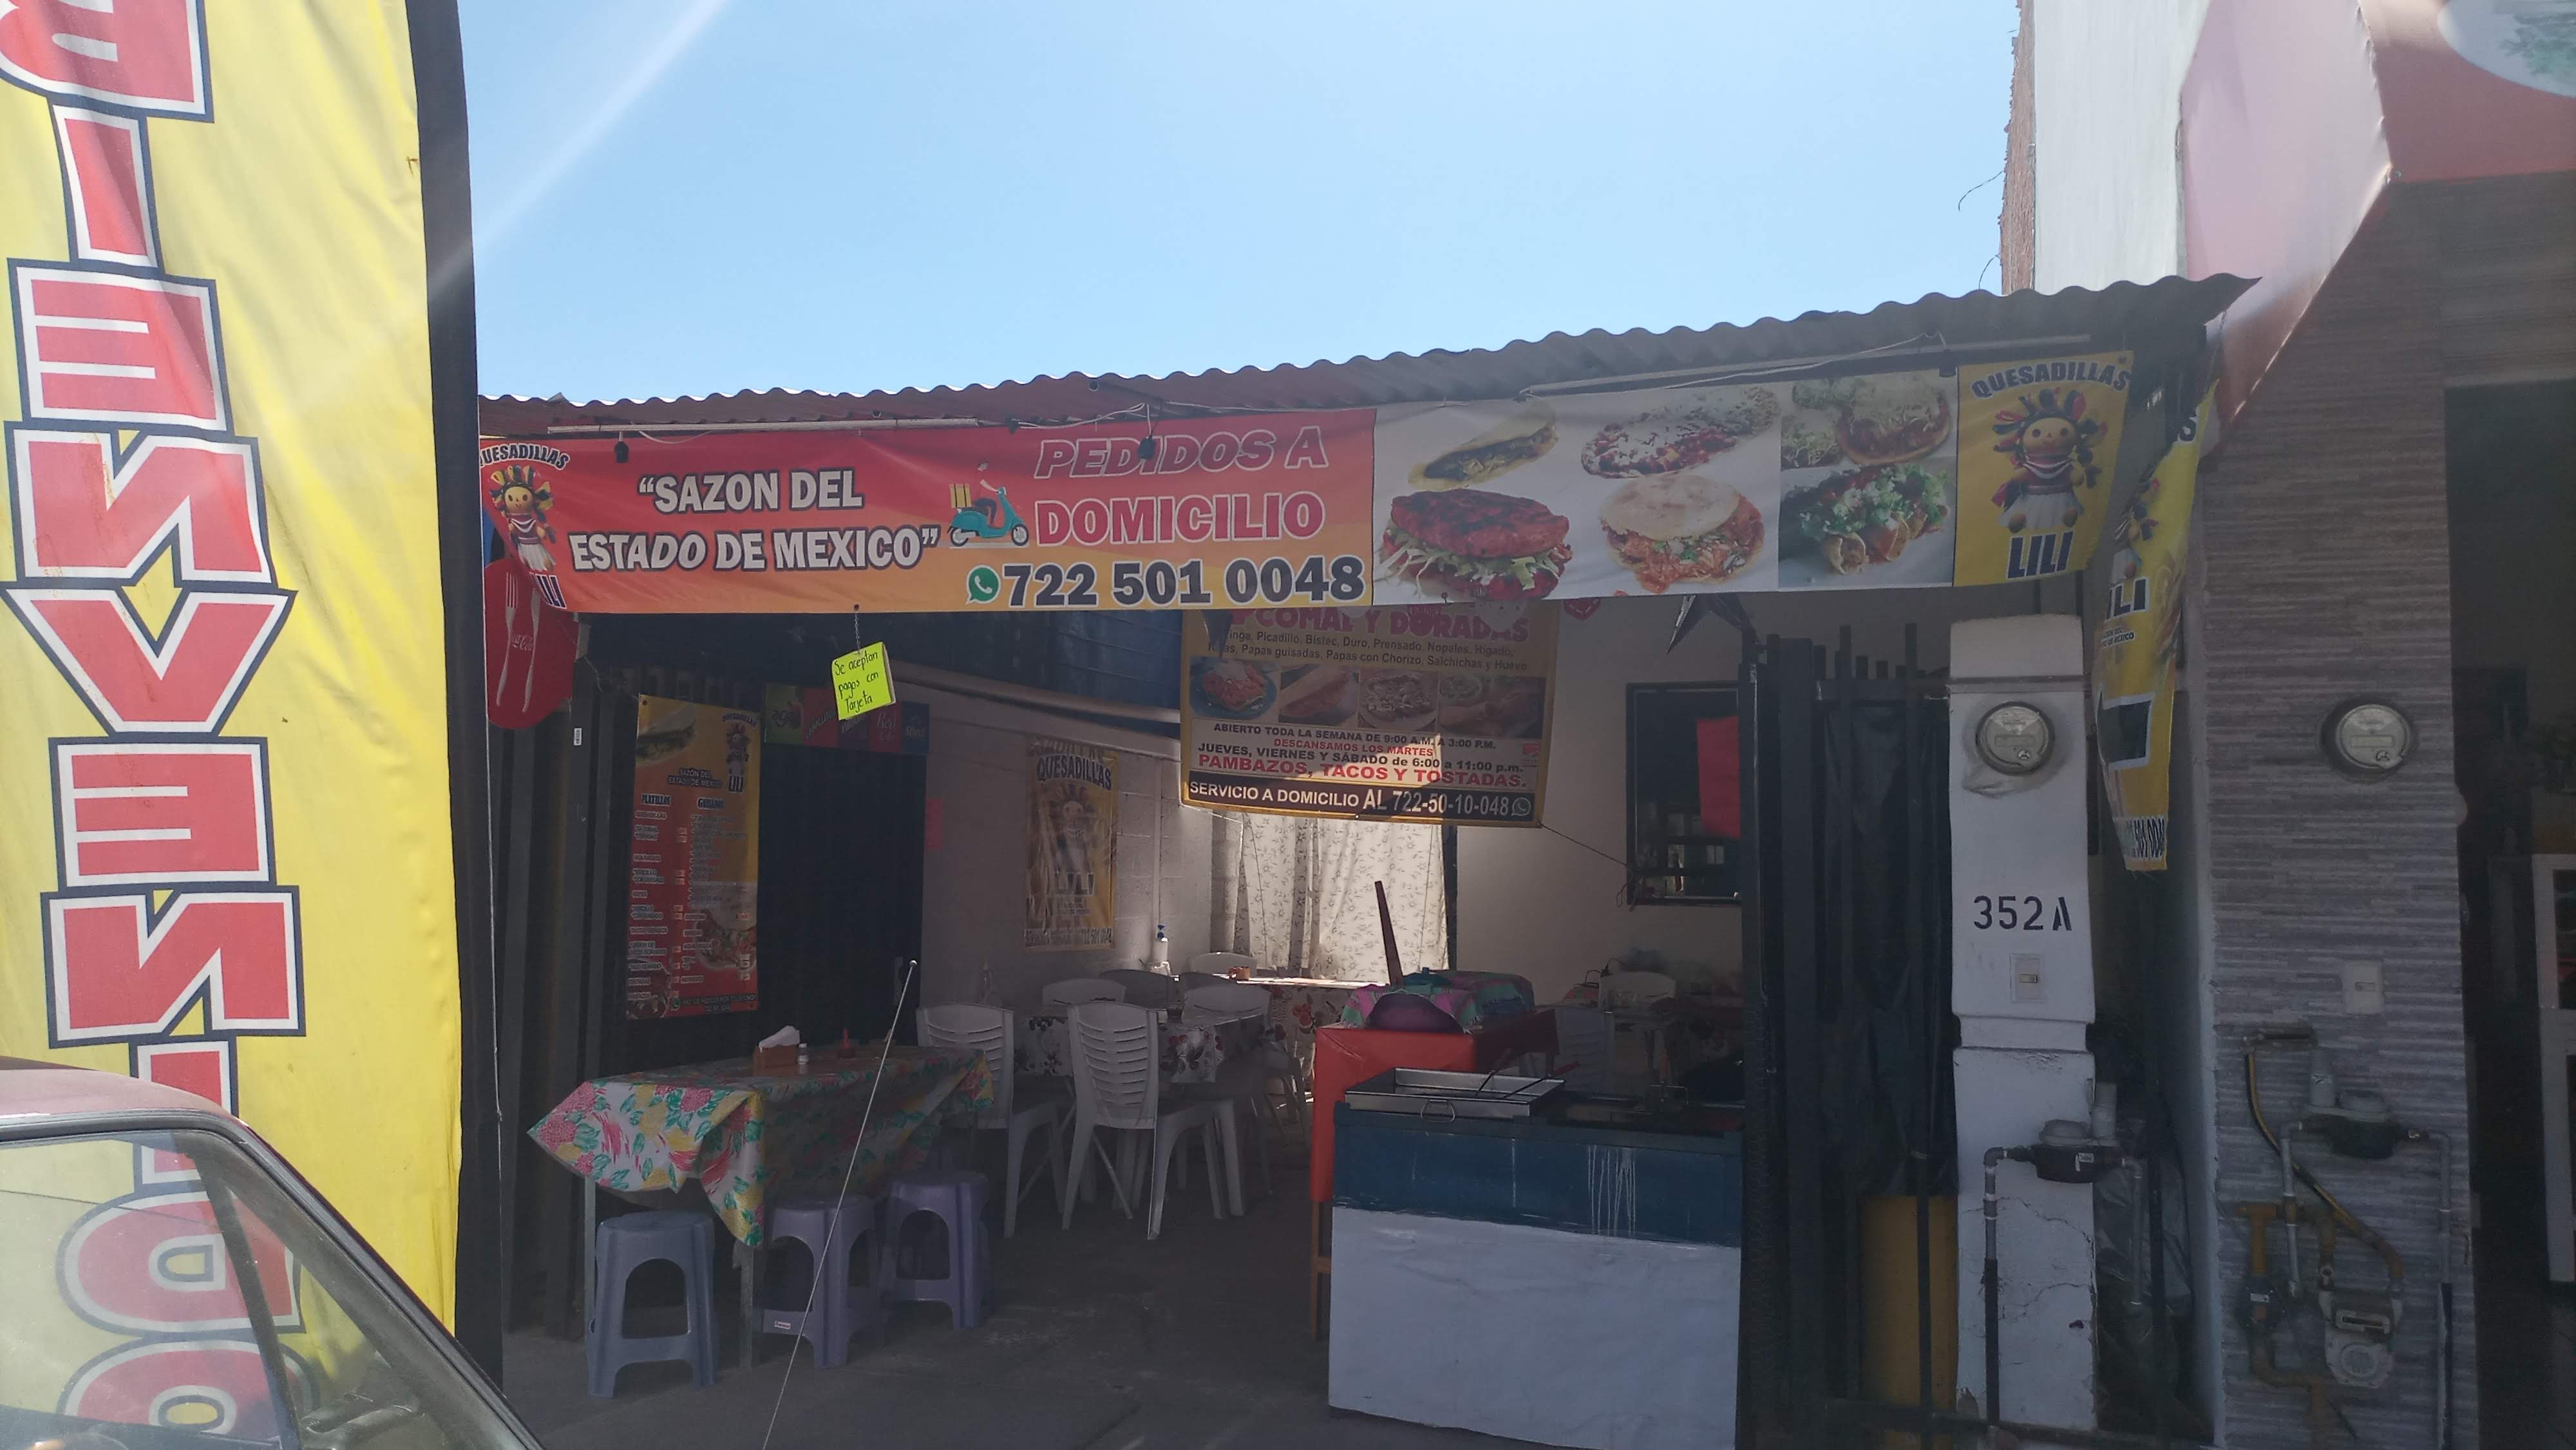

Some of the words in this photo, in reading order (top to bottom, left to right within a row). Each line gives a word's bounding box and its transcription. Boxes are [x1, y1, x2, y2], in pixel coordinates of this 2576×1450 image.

[1971, 362, 2131, 400] QUESADILLAS
[480, 443, 569, 469] UESADILLAS
[1033, 429, 1276, 479] PEDIDOS
[1285, 426, 1329, 469] A
[789, 467, 865, 510] DEL
[1034, 491, 1325, 546] DOMICILIO
[569, 532, 707, 571] ESTADO
[714, 530, 766, 570] DE
[2005, 531, 2074, 581] LILI
[1003, 563, 1097, 607] 722
[1112, 558, 1211, 606] 501
[1225, 554, 1365, 605] 0048
[1255, 607, 1353, 632] COMAL
[1365, 609, 1381, 633] Y
[1229, 631, 1253, 643] inga,
[1306, 636, 1339, 647] Bistec,
[1343, 637, 1370, 649] Duro,
[1242, 644, 1271, 656] Papas
[1275, 648, 1322, 661] guisadas,
[1327, 650, 1357, 662] Papas
[1360, 654, 1379, 662] con
[1427, 655, 1482, 669] Salchichas
[1485, 662, 1492, 671] y
[1494, 661, 1528, 670] Huevo
[834, 660, 845, 676] Se
[848, 650, 878, 671] aceptan
[838, 679, 860, 700] pagos
[866, 672, 879, 683] con
[844, 690, 873, 713] Tarjeta
[1214, 723, 1260, 734] ABIERTO
[1265, 727, 1294, 737] TODA
[1298, 729, 1312, 738] LA
[1316, 730, 1362, 741] SEMANA
[1365, 734, 1381, 743] DE
[1385, 734, 1406, 744] 9:00
[1410, 736, 1435, 746] A.M.
[1437, 737, 1444, 746] A
[1448, 739, 1472, 748] 3:00
[1474, 740, 1496, 749] P.M.
[1274, 739, 1359, 752] DESCANSAMOS
[1362, 744, 1384, 754] LOS
[1388, 746, 1434, 757] MARTES
[1036, 754, 1112, 791] QUESADILLAS
[1198, 743, 1252, 757] JUEVES,
[1256, 747, 1315, 760] VIERNES
[1320, 751, 1329, 761] Y
[1332, 751, 1388, 766] SÁBADO
[1392, 756, 1408, 766] de
[1412, 758, 1440, 768] 6:00
[1457, 760, 1492, 773] 11:00
[1496, 763, 1524, 774] p.m.
[1198, 753, 1313, 778] PAMBAZOS,
[1320, 763, 1388, 780] TACOS
[1393, 767, 1408, 782] Y
[1414, 769, 1526, 788] TOSTADAS.
[1189, 780, 1259, 800] SERVICIO
[1262, 788, 1274, 802] A
[1277, 789, 1359, 807] DOMICILIO
[1363, 788, 1388, 811] AL
[1392, 790, 1509, 816] 722-50-10-048
[1973, 895, 2072, 931] 352A
